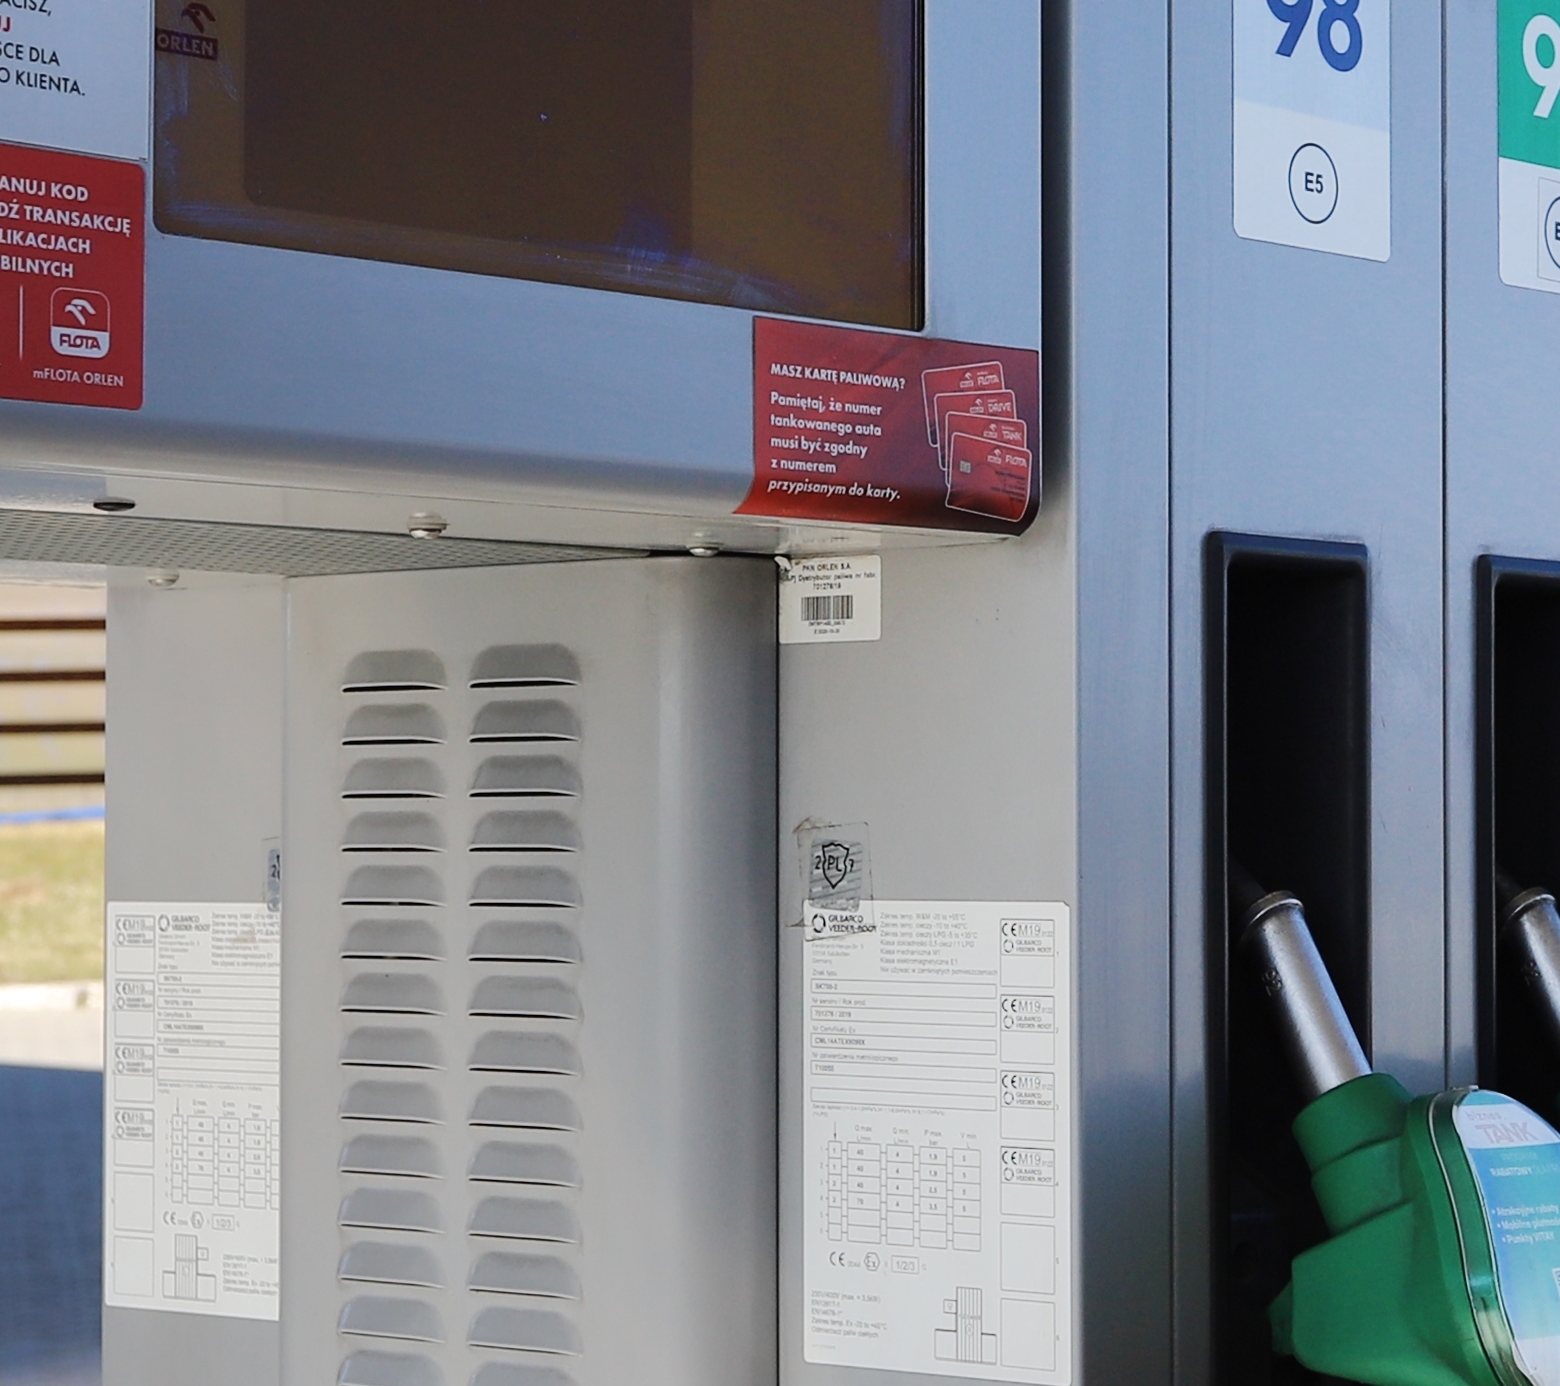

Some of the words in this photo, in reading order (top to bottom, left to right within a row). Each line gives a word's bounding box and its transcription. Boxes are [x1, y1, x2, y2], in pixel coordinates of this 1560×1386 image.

[30, 46, 59, 67] DLA
[16, 70, 85, 96] KLIENTA.
[51, 182, 88, 201] KOD
[1303, 172, 1324, 195] E5
[24, 205, 130, 237] TRANSAKCJĘ
[59, 332, 102, 351] FLOTA
[771, 363, 802, 378] MASZ
[805, 367, 837, 385] KARTĘ
[840, 371, 905, 391] PALIWOWĄ?
[771, 391, 825, 414] Pamiętaj,
[829, 397, 842, 412] że
[845, 403, 882, 415] numer
[771, 413, 852, 436] tankowanego
[855, 424, 881, 436] auta
[771, 438, 798, 449] musi
[801, 435, 820, 454] być
[824, 440, 867, 459] zgodny
[772, 459, 777, 468] z
[781, 460, 836, 473] numerem
[768, 480, 846, 497] przypisanym
[849, 482, 864, 496] do
[866, 483, 900, 502] karty.
[1018, 925, 1041, 937] M19
[1476, 1119, 1539, 1144] TANK
[1490, 1165, 1533, 1178] RABATOWY
[1506, 1232, 1534, 1246] Punkty
[1534, 1231, 1555, 1242] VITAY
